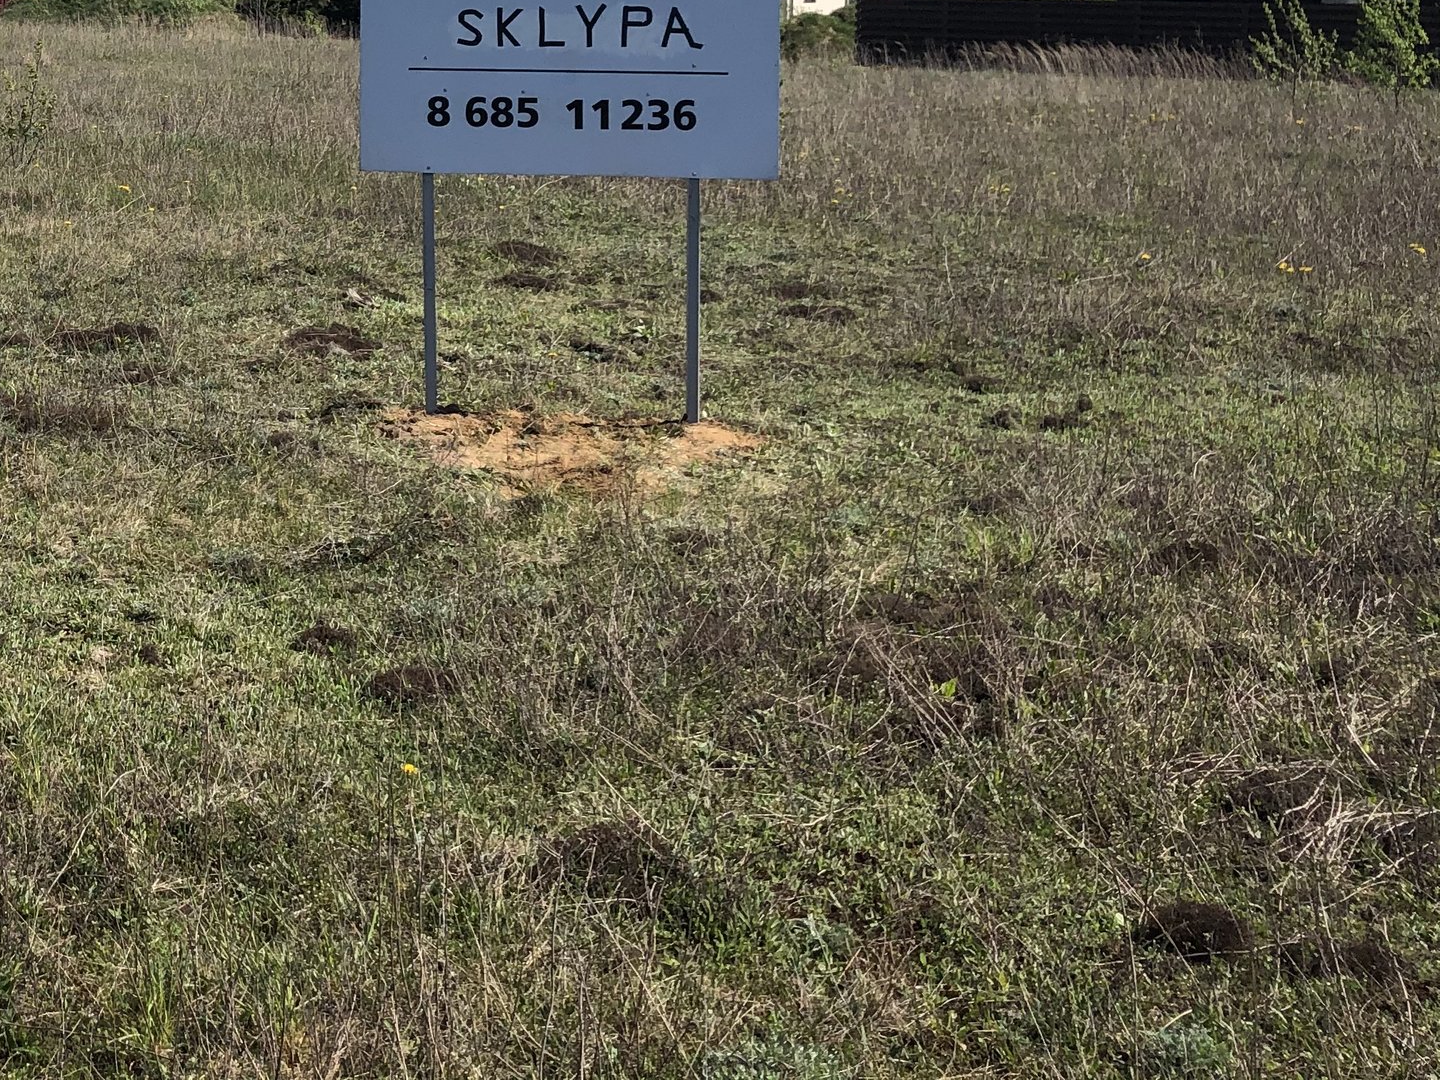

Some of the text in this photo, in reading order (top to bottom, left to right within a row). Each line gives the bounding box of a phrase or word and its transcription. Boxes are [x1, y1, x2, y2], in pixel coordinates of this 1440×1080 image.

[427, 95, 698, 132] 8 685 11236
